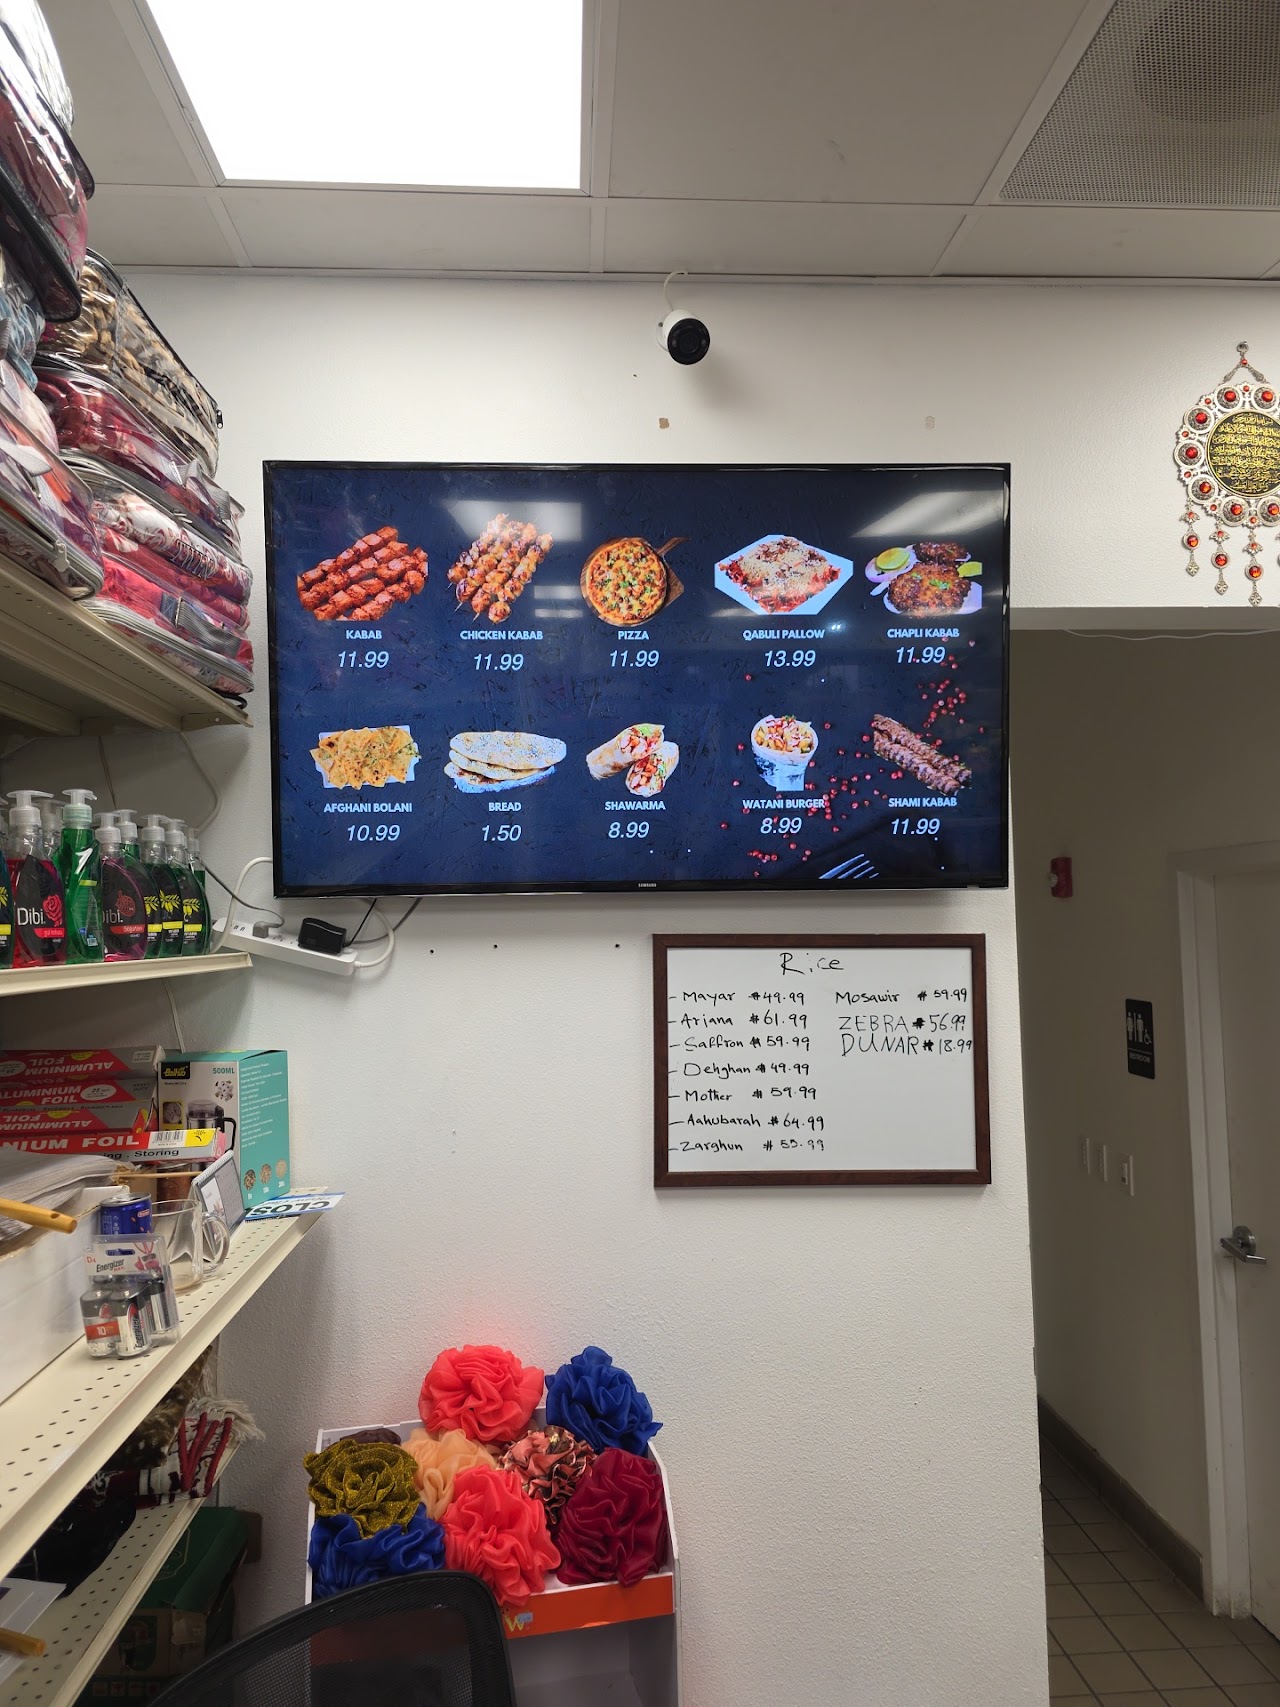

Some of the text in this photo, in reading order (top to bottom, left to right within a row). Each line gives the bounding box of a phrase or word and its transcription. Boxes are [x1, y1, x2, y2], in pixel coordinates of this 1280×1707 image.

[346, 629, 382, 640] KABAB
[460, 630, 543, 640] CHICKEN KABAB
[618, 630, 649, 640] PIZZA
[743, 629, 825, 641] QABULI PALLOW
[887, 628, 960, 639] CHAPLI KABAB
[337, 651, 389, 668] 11.99
[473, 653, 524, 671] 11.99
[609, 650, 660, 668] 11.99
[764, 650, 816, 667] 13.99
[896, 647, 946, 664] 11.99
[324, 803, 412, 813] AFGHANI BOLANI
[488, 802, 522, 812] BREAD
[605, 801, 666, 811] SHAWARMA
[743, 799, 825, 809] WATANI BURGER
[888, 797, 957, 808] SHAMI KABAB
[481, 825, 521, 841] 1.50
[608, 822, 650, 839] 8.99
[760, 818, 802, 834] 8.99
[891, 818, 941, 835] 11.99
[347, 825, 400, 842] 10.99
[780, 952, 844, 975] Rice
[683, 991, 736, 1007] Mayar
[835, 990, 900, 1006] Mosawir
[681, 1013, 733, 1029] Ariana
[838, 1014, 909, 1033] ZEBRA
[684, 1034, 744, 1051] Saffron
[841, 1033, 919, 1057] DUNAR
[29, 1056, 65, 1066] FOIL
[25, 1061, 114, 1076] ALUMINIUM
[213, 1067, 235, 1075] 500ML
[683, 1062, 750, 1080] Dehghan
[41, 1095, 78, 1105] FOIL
[685, 1088, 733, 1101] Mother
[3, 1114, 41, 1122] FOIL
[82, 1135, 140, 1148] FOIL
[680, 1139, 743, 1153] Zarghun
[134, 1149, 179, 1158] Storing
[96, 1259, 125, 1273] Energizer
[96, 1326, 107, 1336] 10
